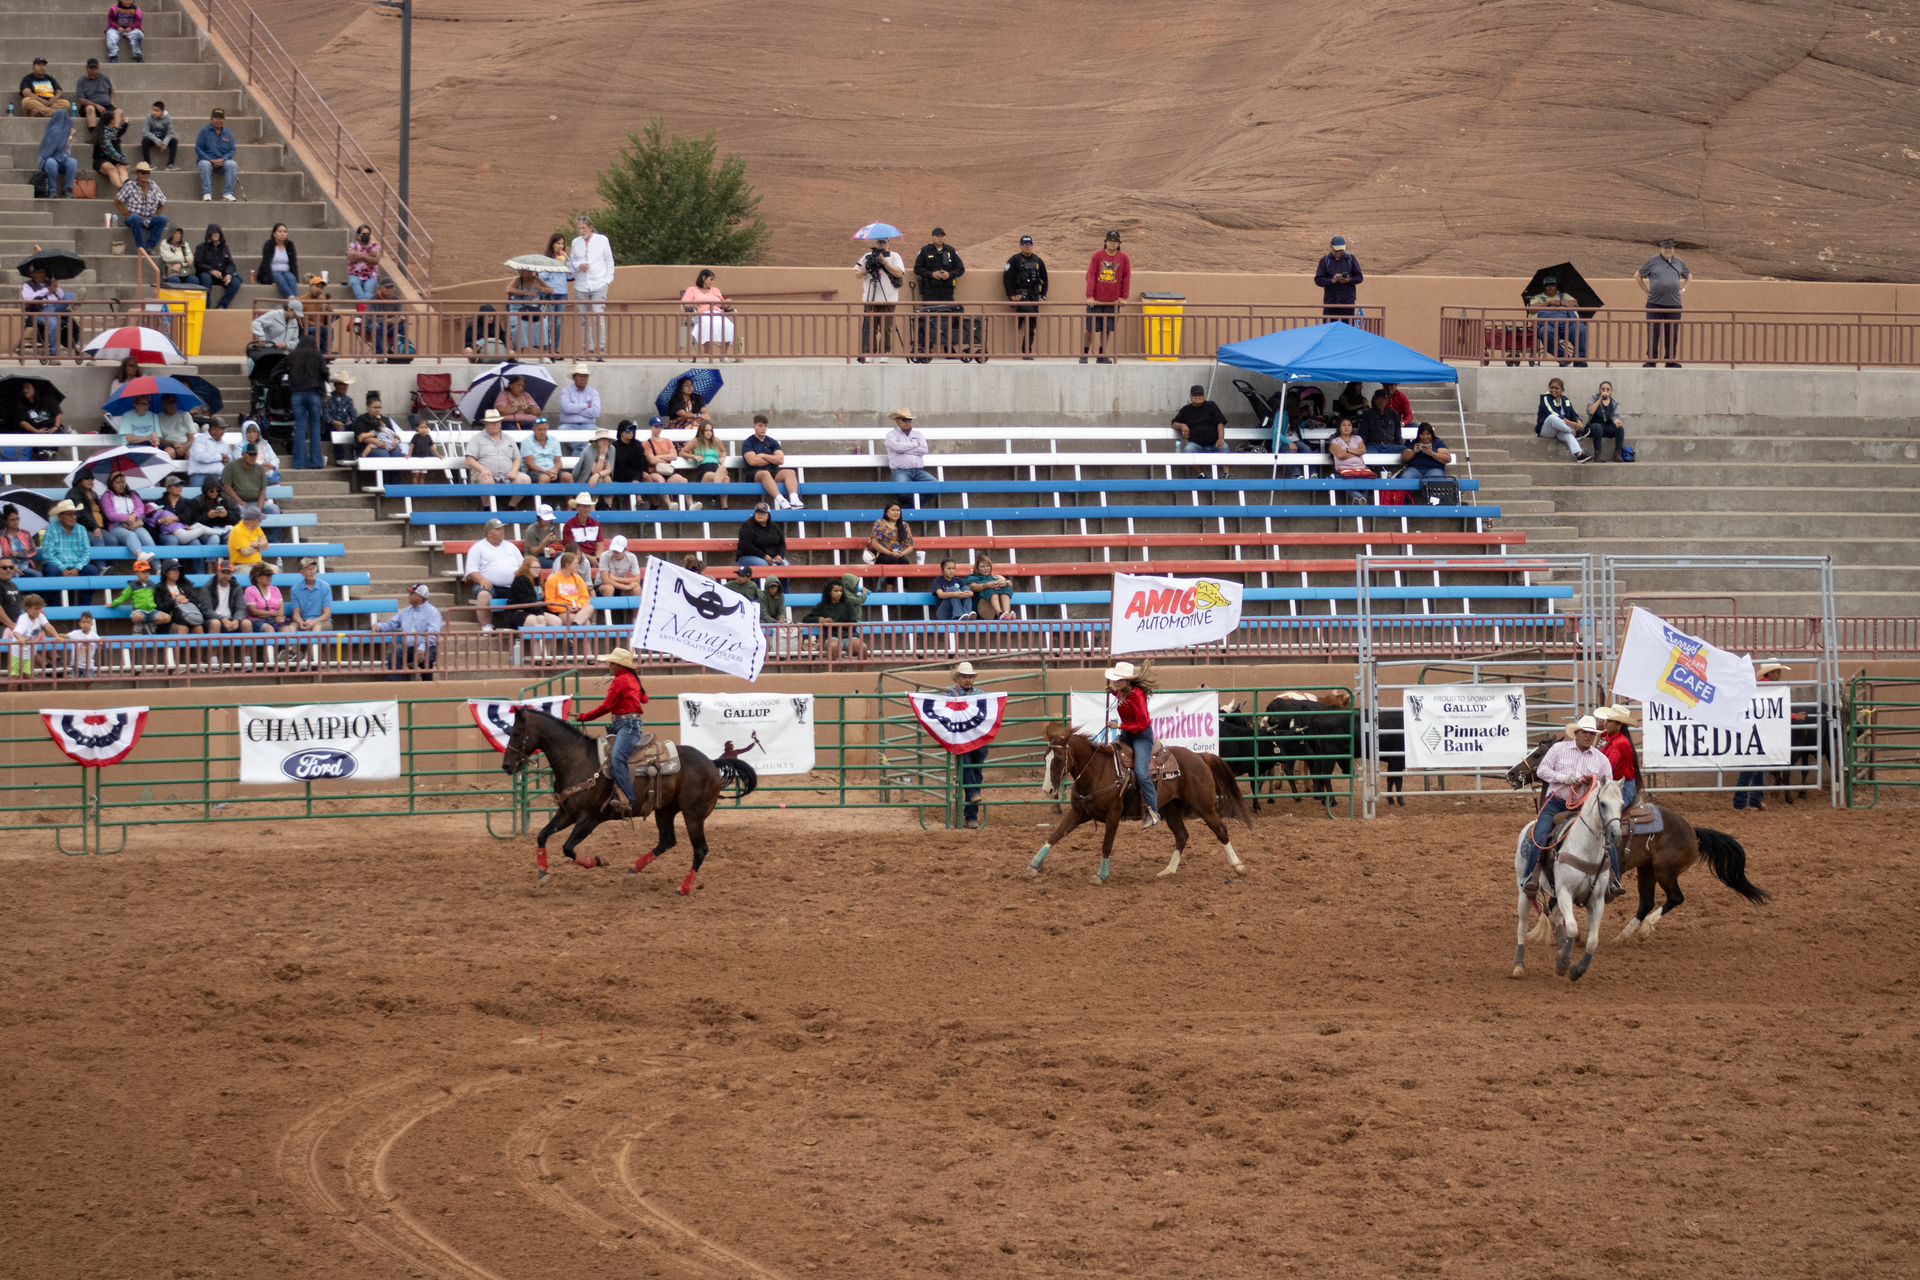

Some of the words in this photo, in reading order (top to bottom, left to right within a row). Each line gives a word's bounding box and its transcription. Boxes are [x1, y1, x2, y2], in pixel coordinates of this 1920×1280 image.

[1136, 610, 1213, 632] AUTOMOTIVE
[661, 612, 746, 660] Navajo
[683, 639, 707, 652] CRAFTS
[1673, 667, 1712, 700] CAFE
[713, 700, 737, 708] PROUD
[749, 698, 780, 706] SPONSOR
[1466, 694, 1496, 702] SPONSOR
[1649, 697, 1783, 721] MILIUM
[247, 713, 387, 742] CHAMPION
[1150, 706, 1214, 740] urniture
[1444, 724, 1510, 738] Pinnacle
[1193, 743, 1216, 752] Carpet
[1444, 739, 1484, 752] Bank
[1663, 723, 1766, 757] MEDIA
[296, 753, 343, 777] Ford
